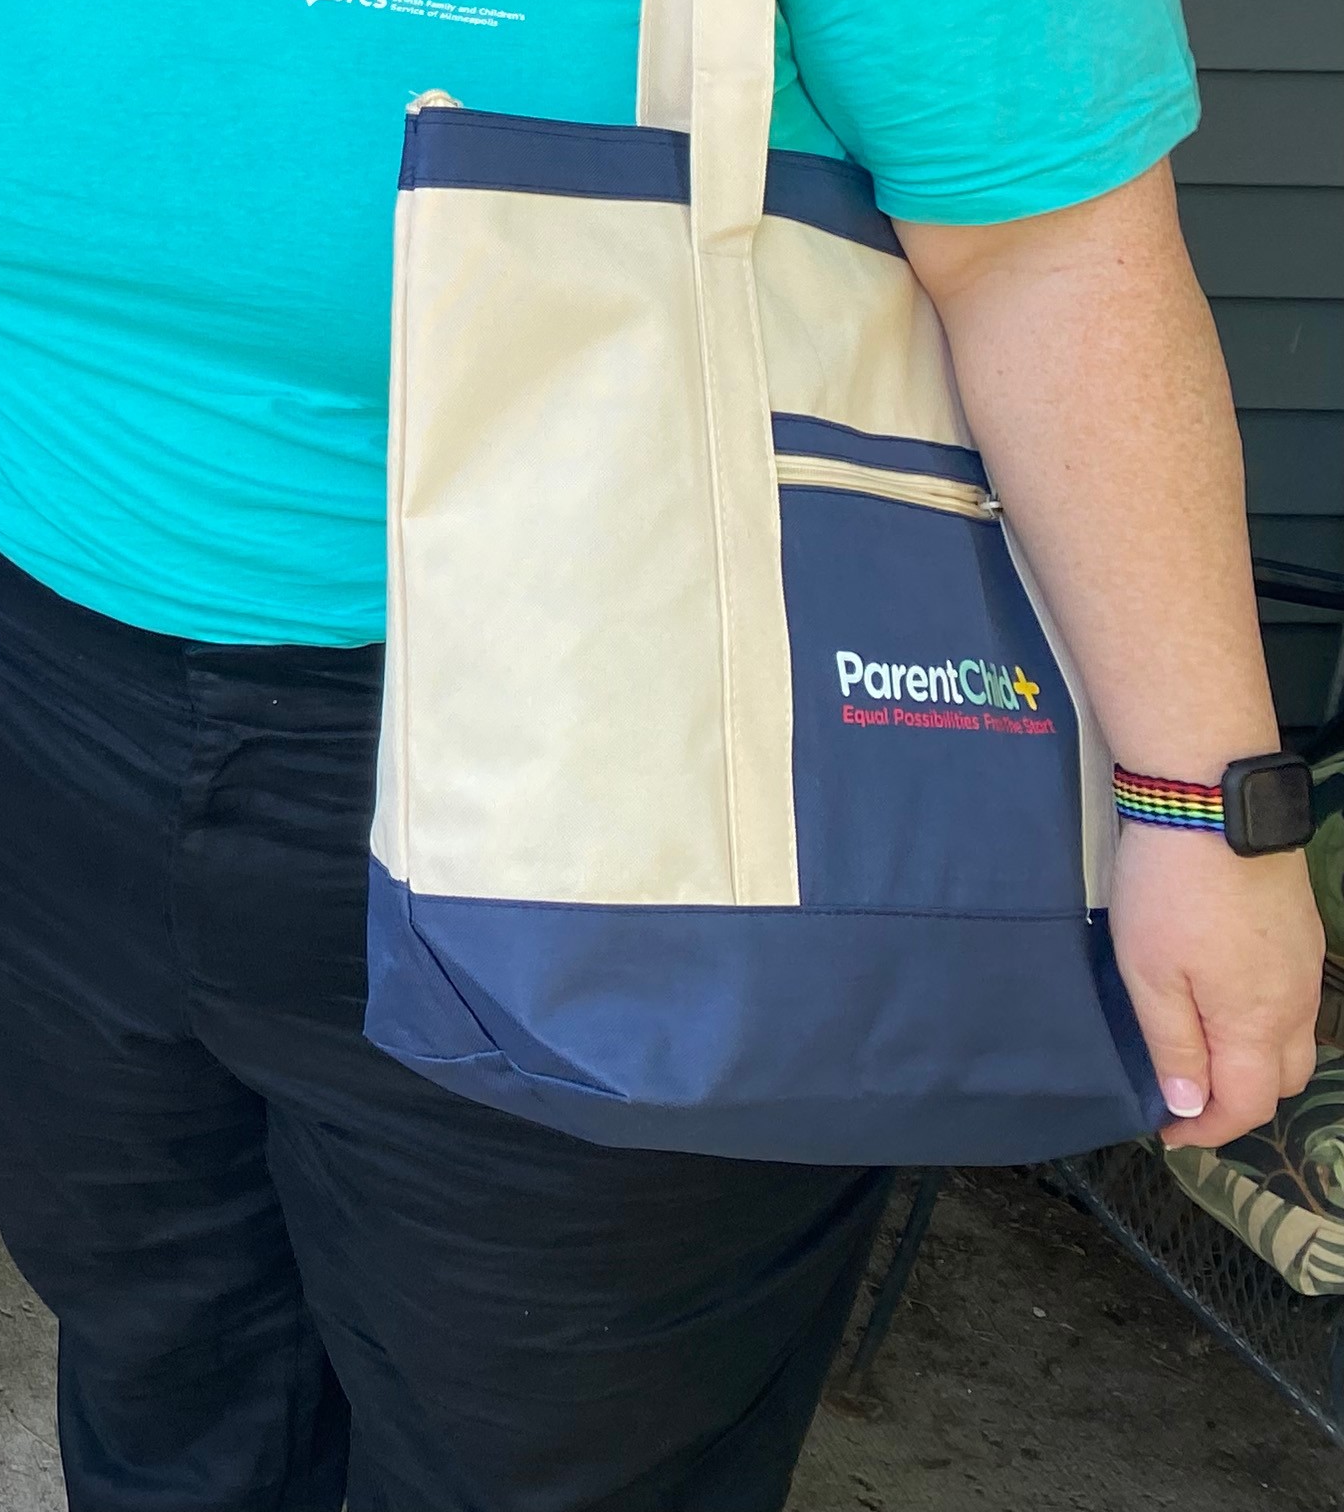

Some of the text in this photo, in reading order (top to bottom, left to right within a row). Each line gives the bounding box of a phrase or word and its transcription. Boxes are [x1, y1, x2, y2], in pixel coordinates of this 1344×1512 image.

[389, 3, 499, 28] Service of Minneapolis
[426, 0, 457, 12] Family
[458, 6, 477, 15] and
[842, 704, 889, 727] Equal
[893, 707, 980, 730] Possibilities
[1022, 715, 1057, 735] Start
